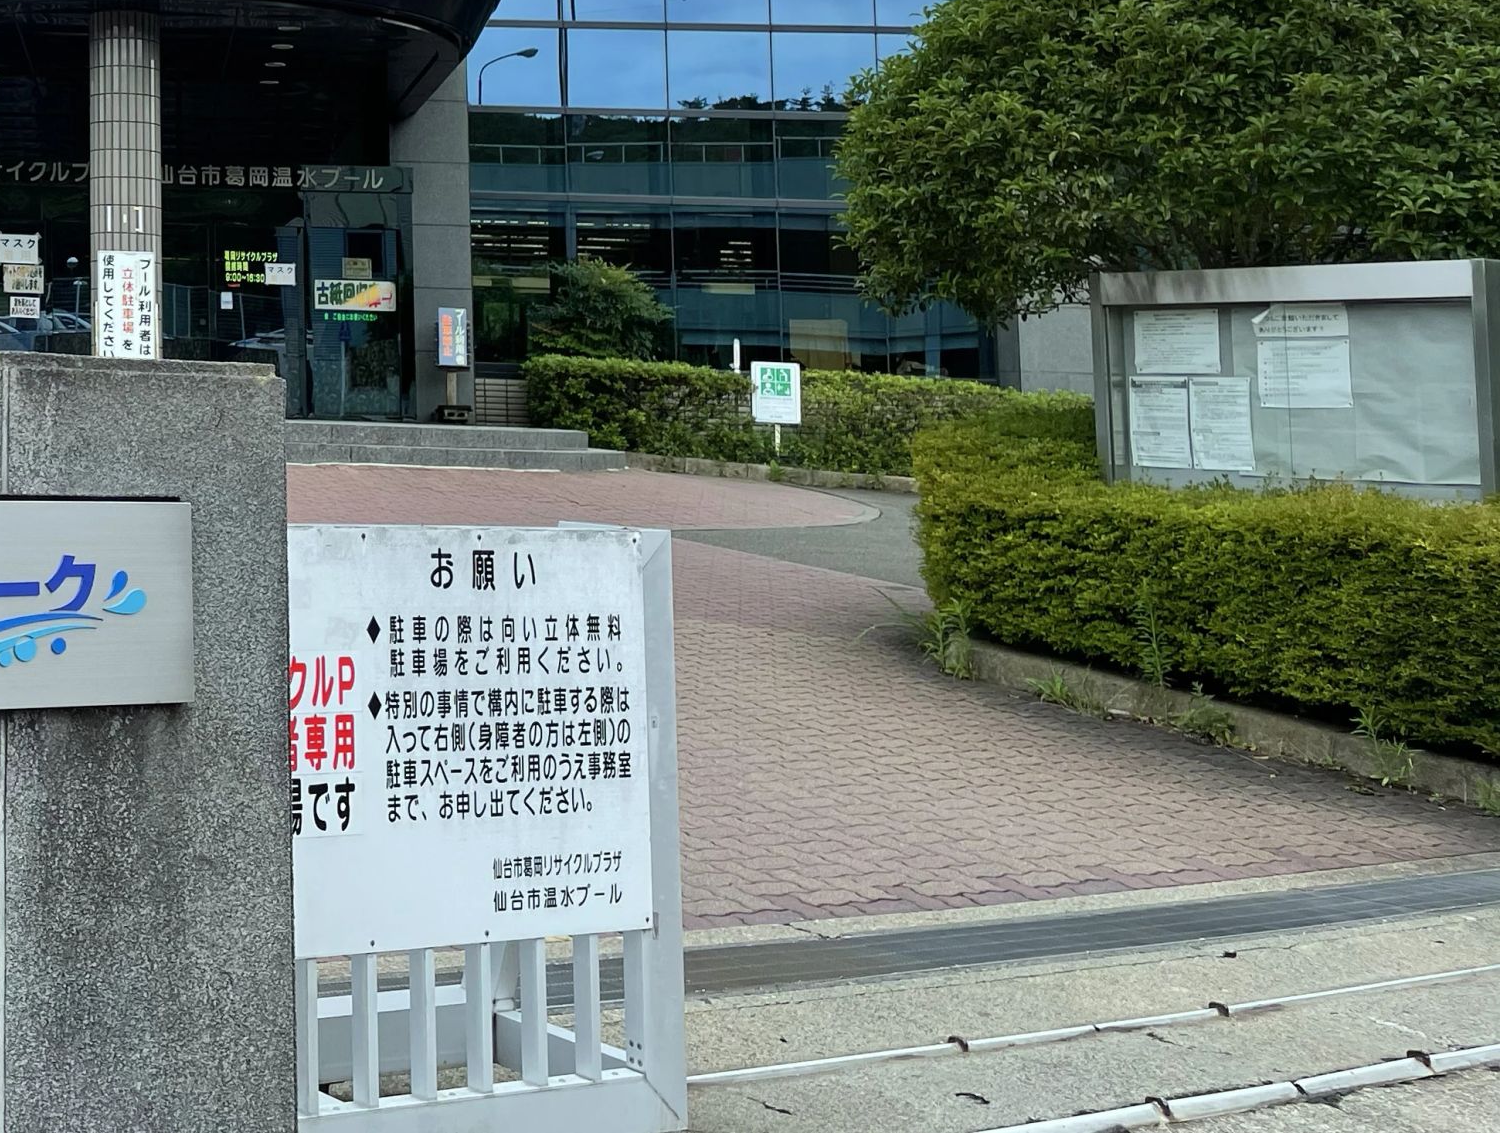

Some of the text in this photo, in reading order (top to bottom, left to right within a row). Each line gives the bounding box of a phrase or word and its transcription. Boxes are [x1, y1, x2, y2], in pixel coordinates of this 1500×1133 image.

[430, 548, 536, 591] お願い
[389, 613, 622, 645] 駐車の際は向い立体無料
[389, 646, 623, 678] 駐車場をご利用ください。
[385, 686, 630, 720] 特別の事情で構内に駐車する際は
[386, 718, 631, 755] 入って右側(身障者の方は左側)の
[386, 751, 632, 789] 駐車スペースをご利用のうえ事務室
[387, 786, 593, 823] まで、お申し出てください。
[493, 850, 622, 880] 仙台市葛岡リサイクルプラザ
[493, 883, 623, 913] 仙台市温水プール
